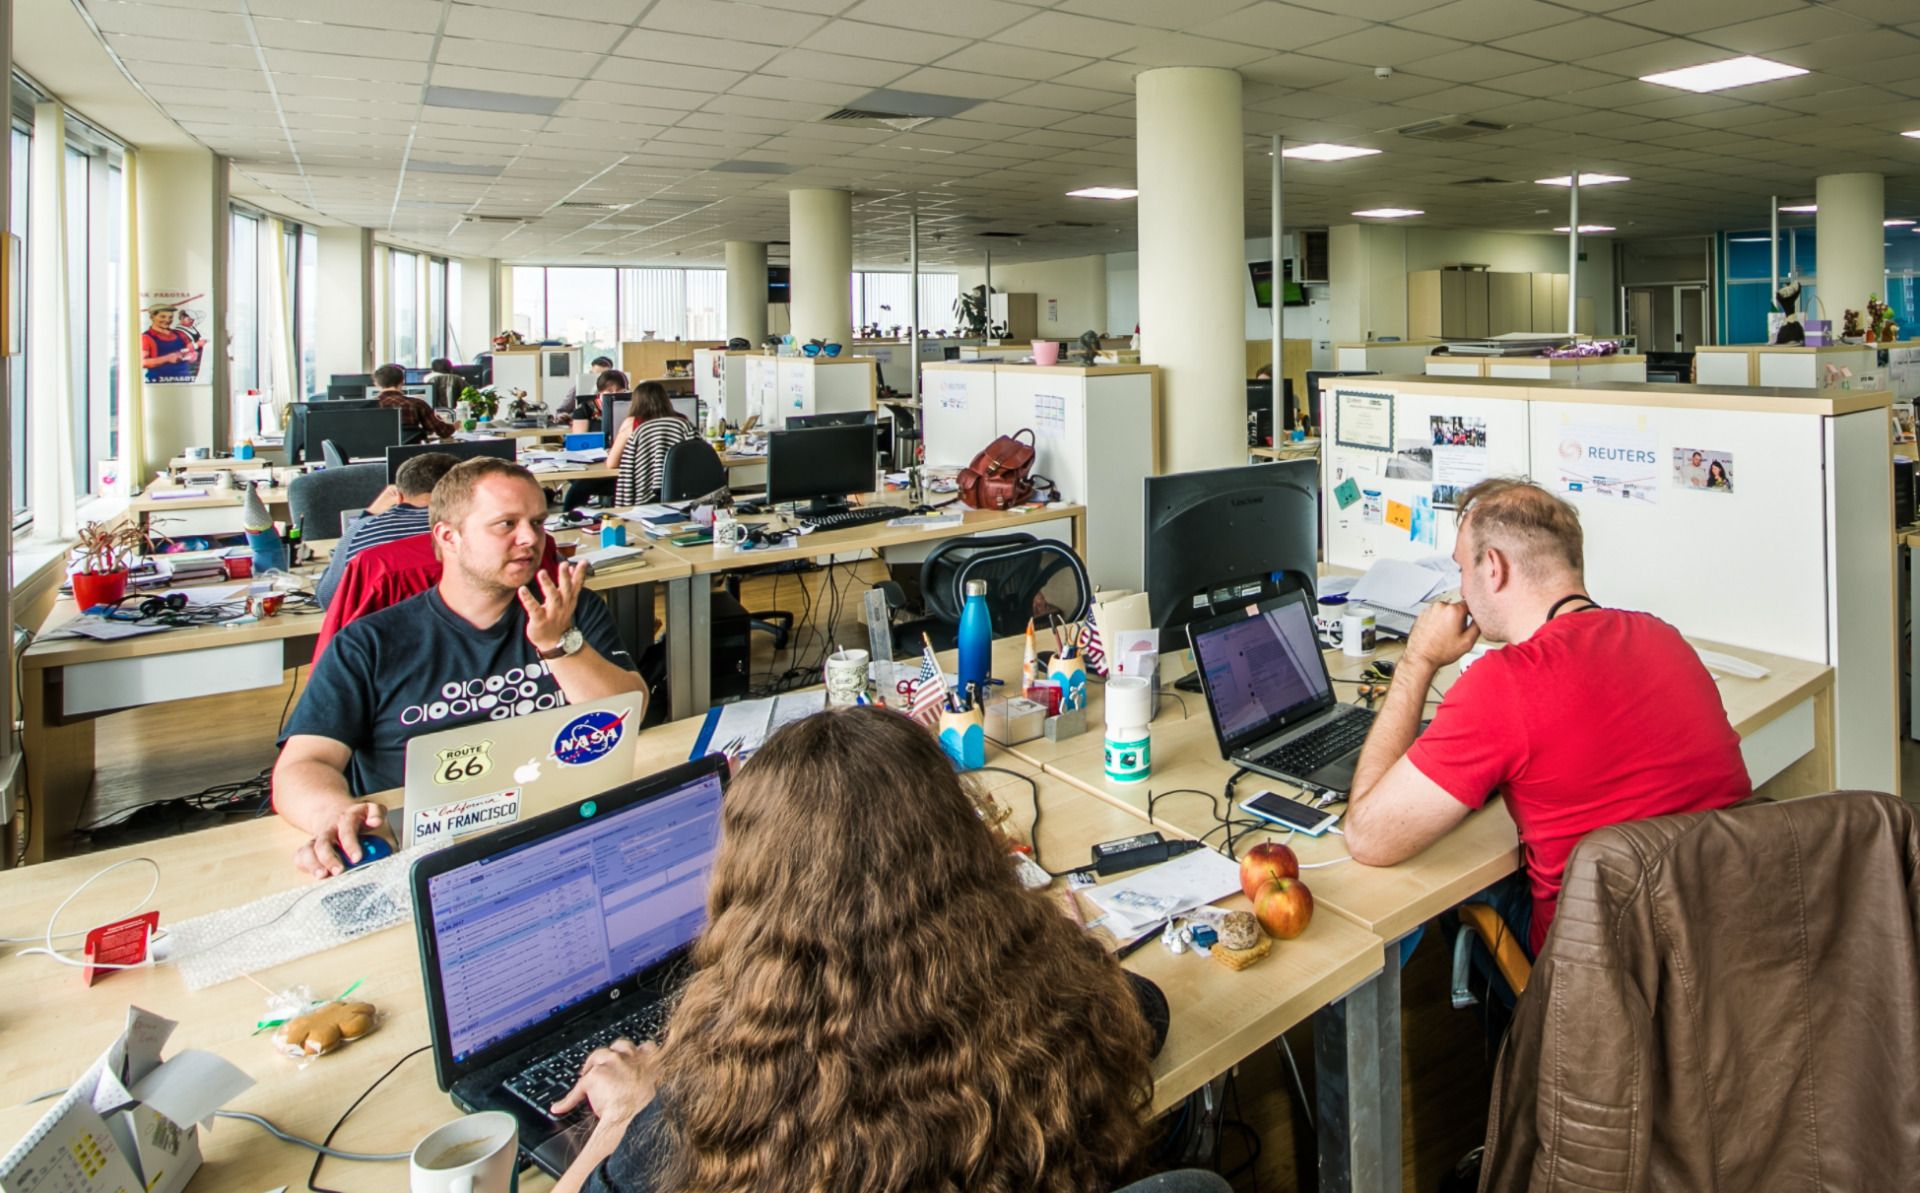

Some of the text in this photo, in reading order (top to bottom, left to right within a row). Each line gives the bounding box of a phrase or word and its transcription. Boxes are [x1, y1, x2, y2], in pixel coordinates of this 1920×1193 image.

[1588, 445, 1656, 464] REUTERS
[559, 727, 619, 753] NASA
[446, 745, 482, 759] ROUTE
[444, 756, 484, 781] 66
[437, 798, 496, 817] California
[416, 802, 517, 838] SAN FRANCISCO
